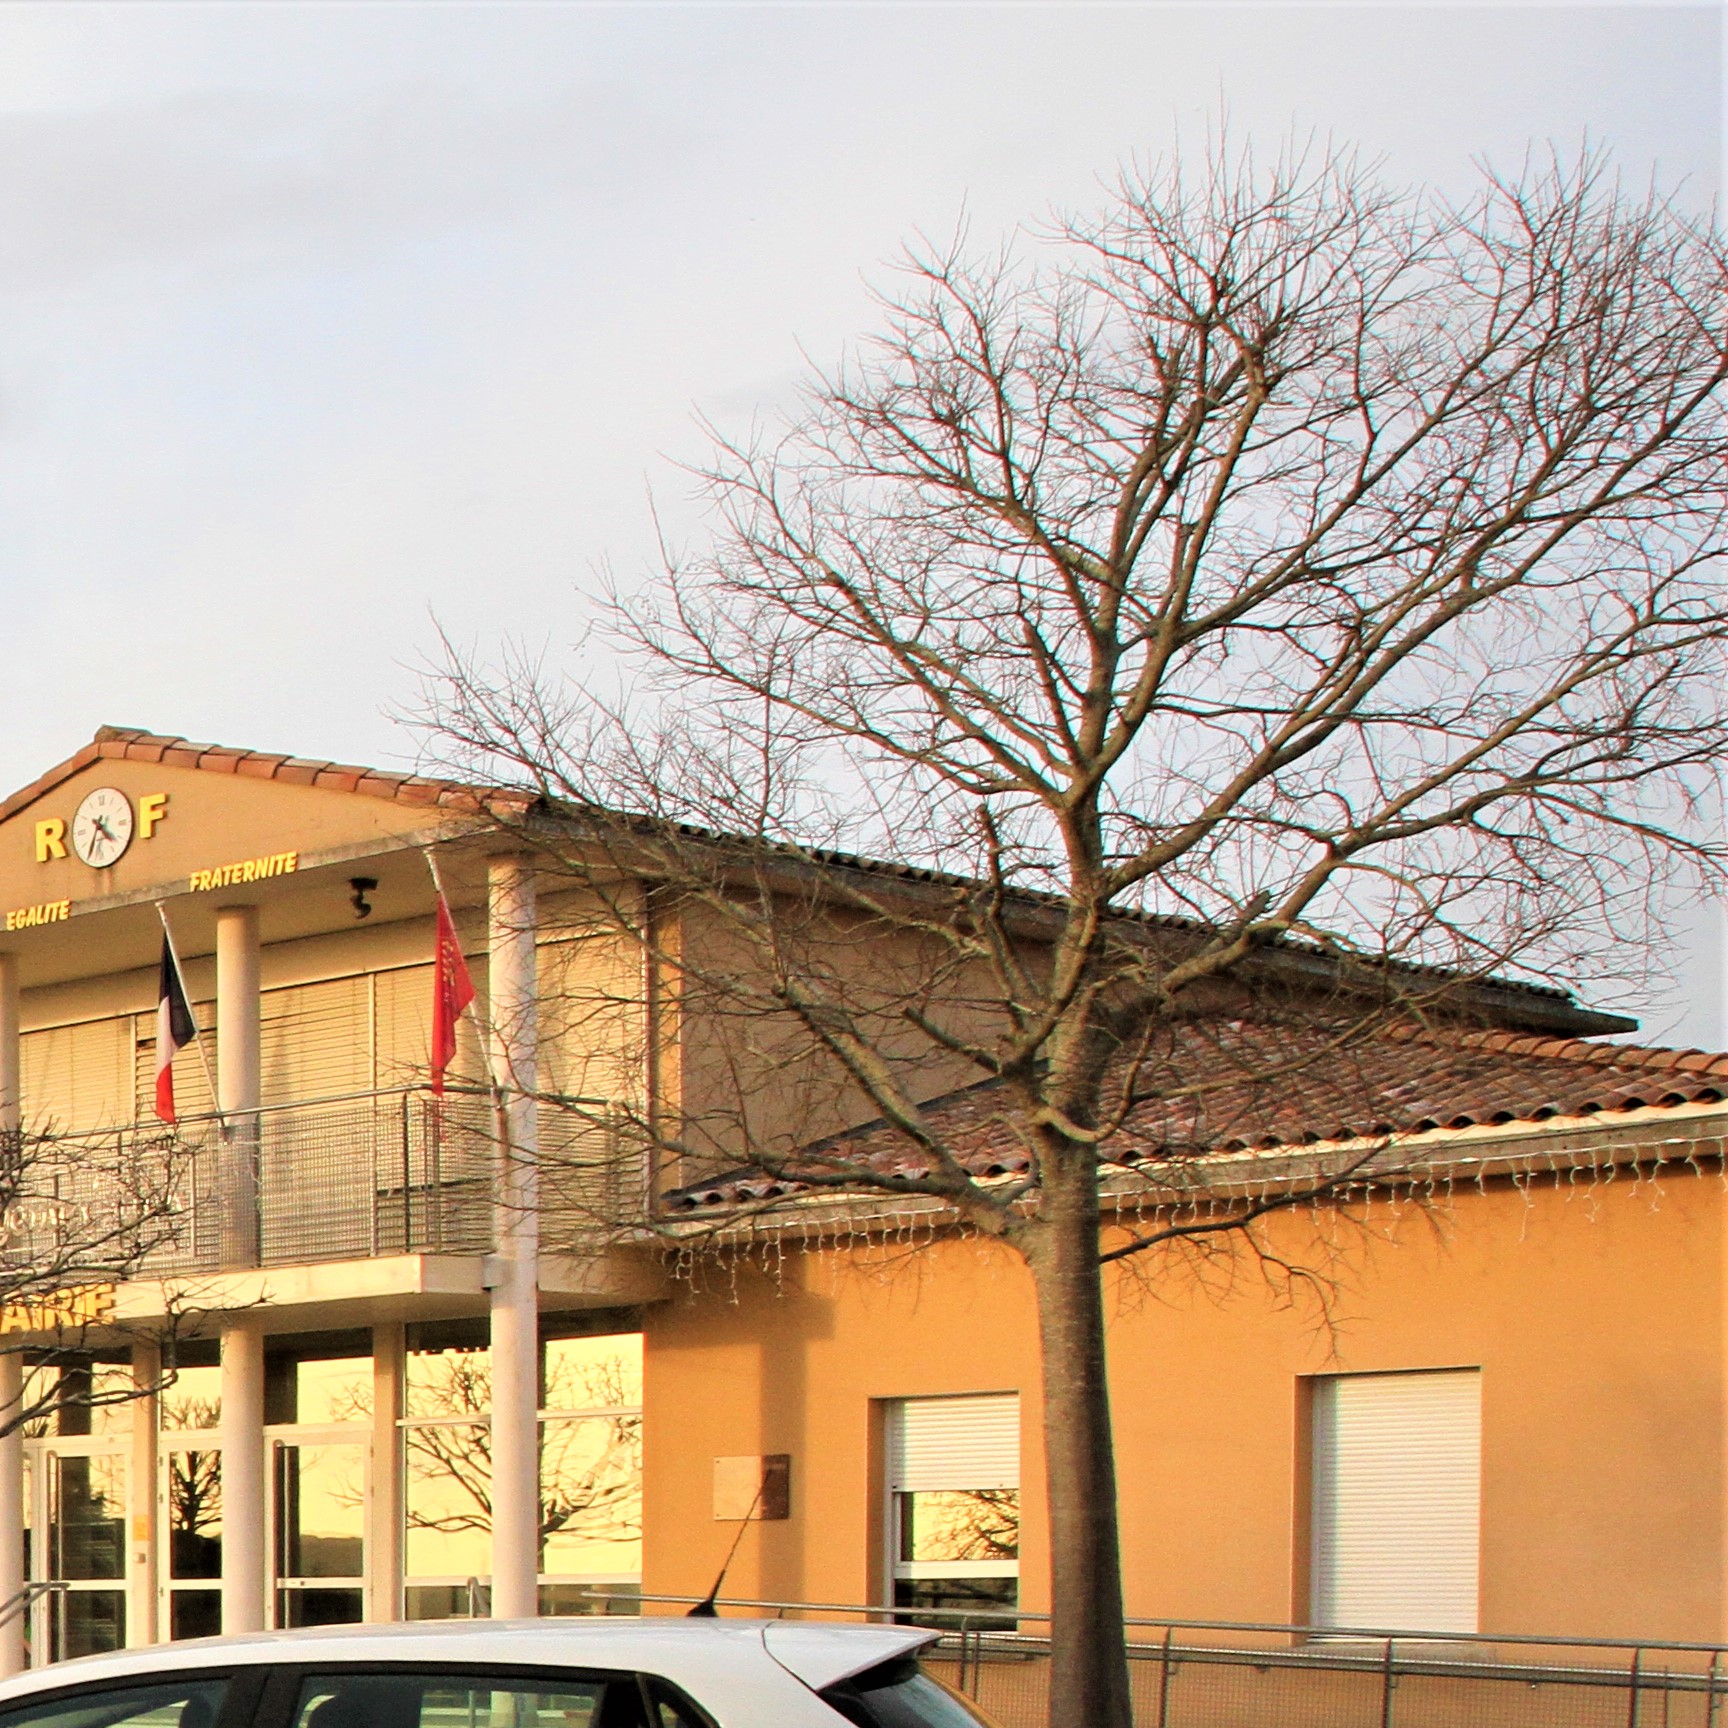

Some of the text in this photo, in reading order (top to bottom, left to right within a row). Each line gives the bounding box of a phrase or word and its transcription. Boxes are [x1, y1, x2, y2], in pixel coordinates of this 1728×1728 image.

[35, 793, 167, 862] R F
[189, 850, 297, 892] FRATERNITE
[6, 899, 70, 931] EGALITE
